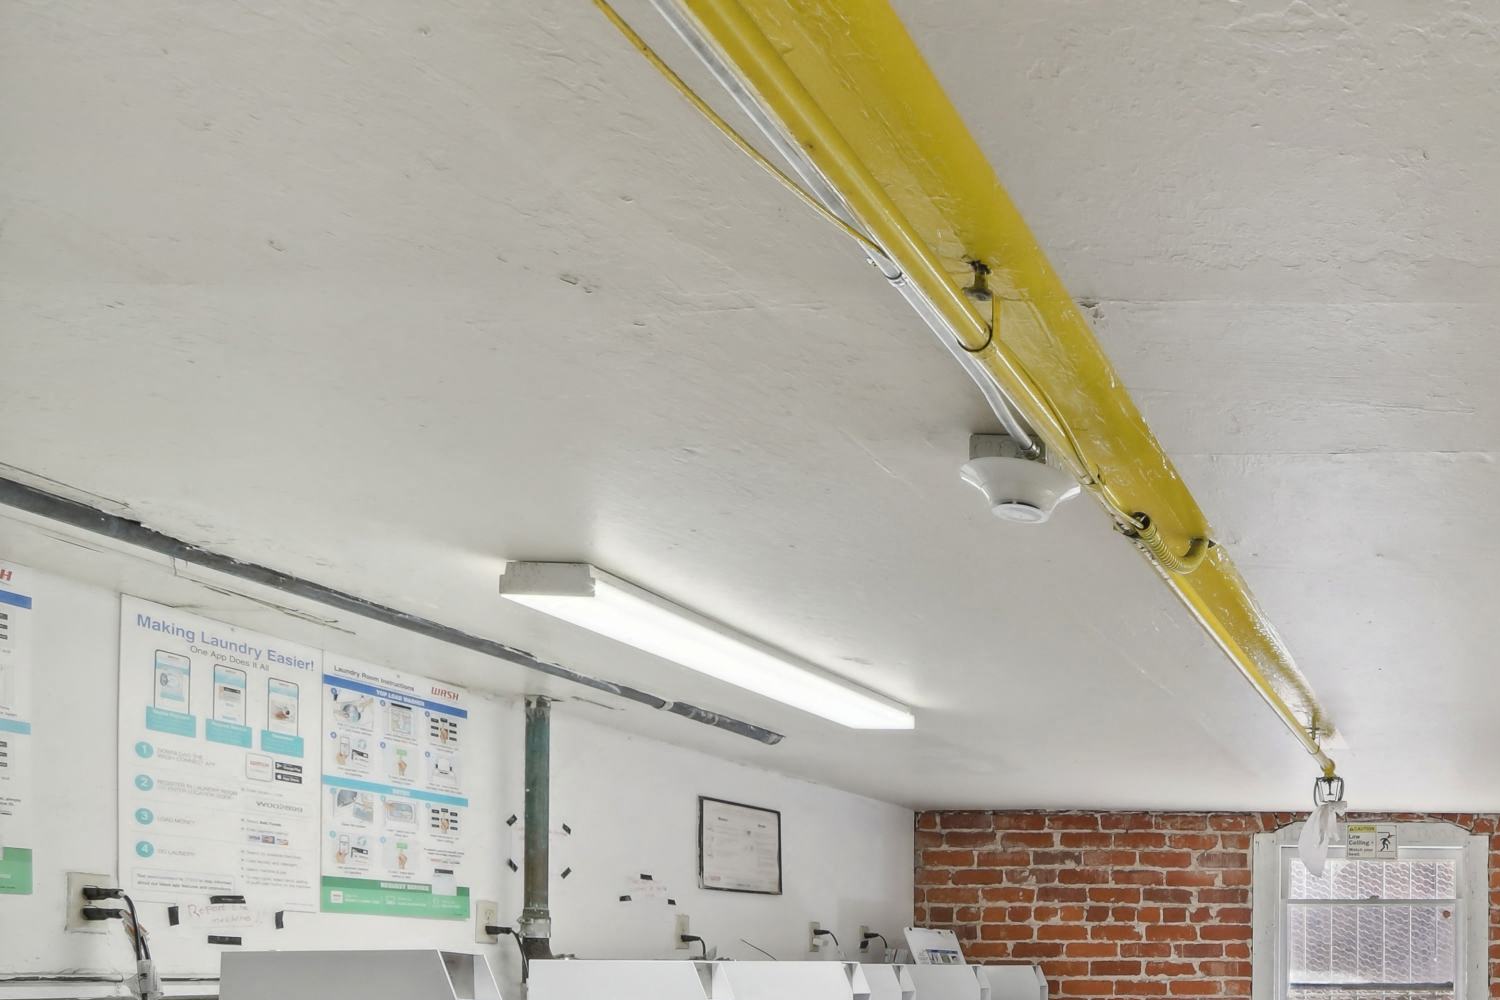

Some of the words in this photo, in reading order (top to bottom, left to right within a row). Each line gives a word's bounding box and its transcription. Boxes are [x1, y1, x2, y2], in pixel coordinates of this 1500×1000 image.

[137, 613, 196, 643] Making
[201, 631, 262, 660] Laundry
[267, 649, 314, 672] Easier!
[190, 645, 209, 656] One
[210, 649, 228, 663] App
[229, 655, 250, 668] Does
[259, 662, 270, 672] All
[334, 665, 360, 679] Laundry
[361, 673, 380, 683] Room
[431, 686, 459, 701] WASH
[142, 743, 148, 754] 1
[141, 777, 149, 788] 2
[141, 811, 149, 821] 3
[141, 844, 149, 854] 4
